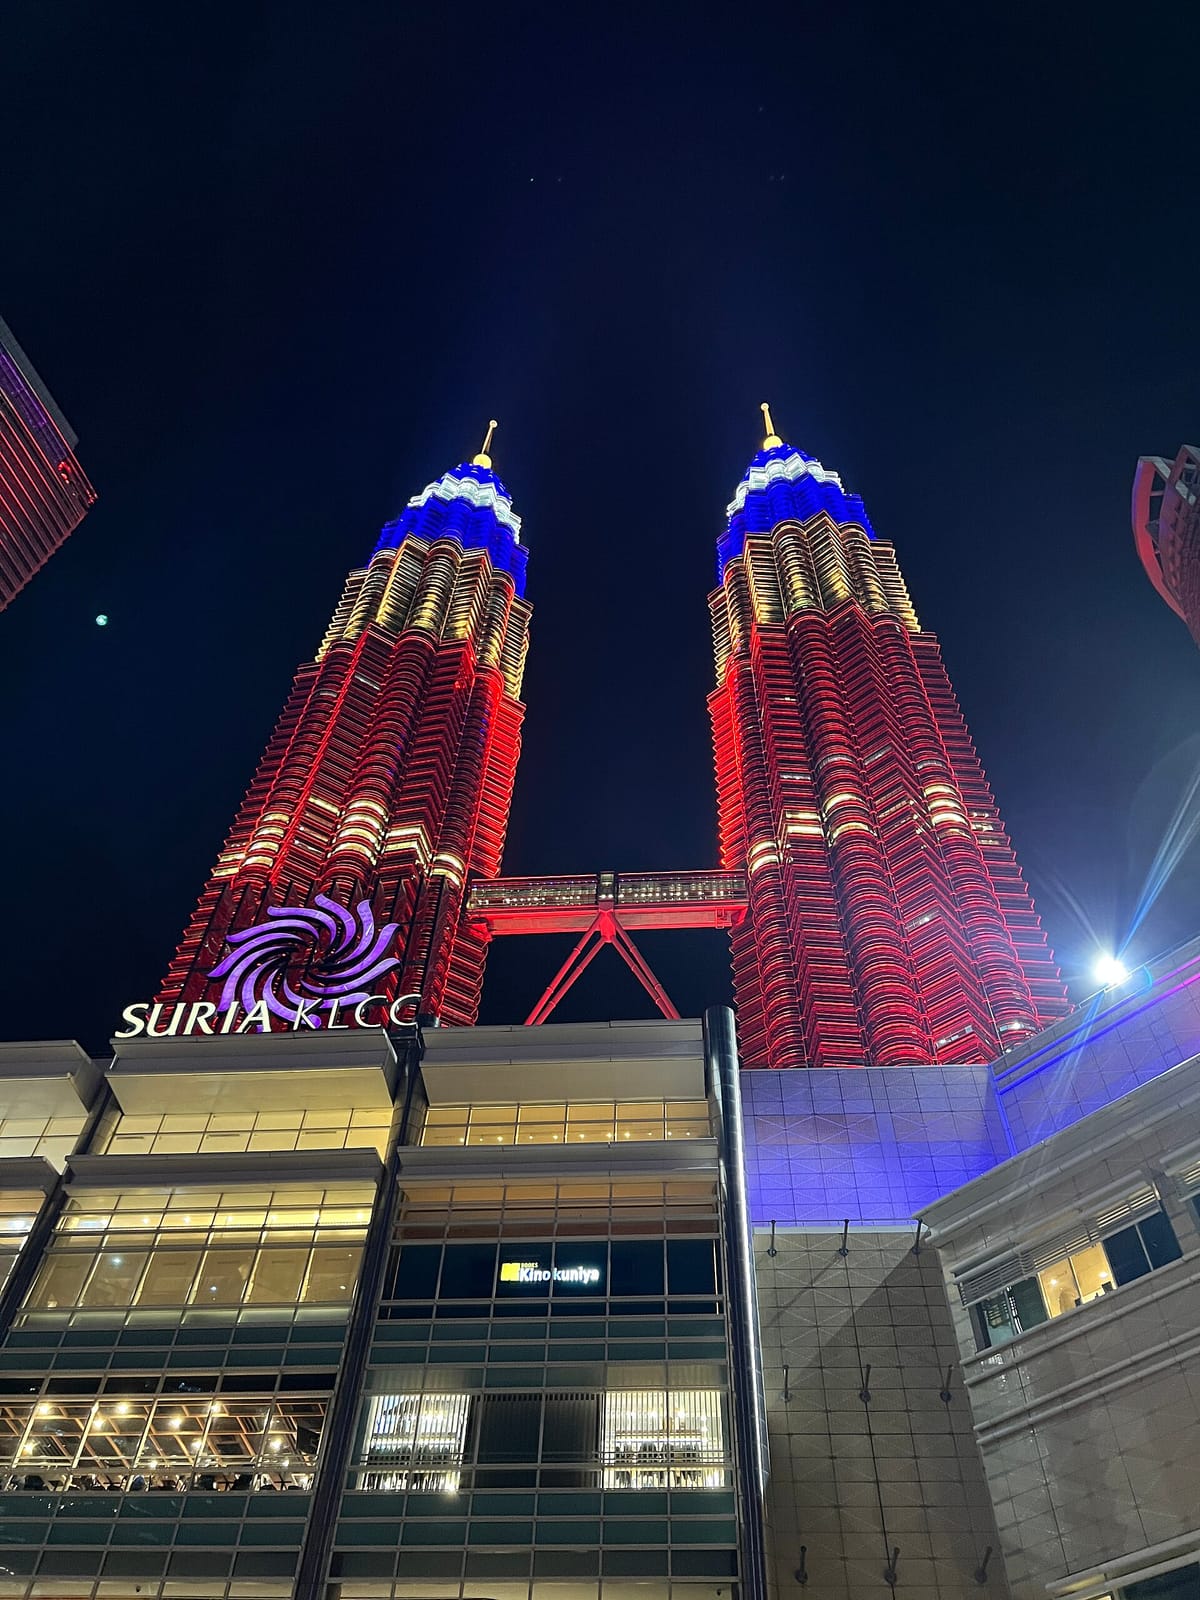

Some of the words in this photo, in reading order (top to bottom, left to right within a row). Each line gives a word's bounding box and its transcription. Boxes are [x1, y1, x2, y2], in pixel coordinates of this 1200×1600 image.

[114, 1001, 272, 1038] SURIA
[292, 994, 422, 1031] KLCC
[519, 1266, 599, 1284] Kinokuniya
